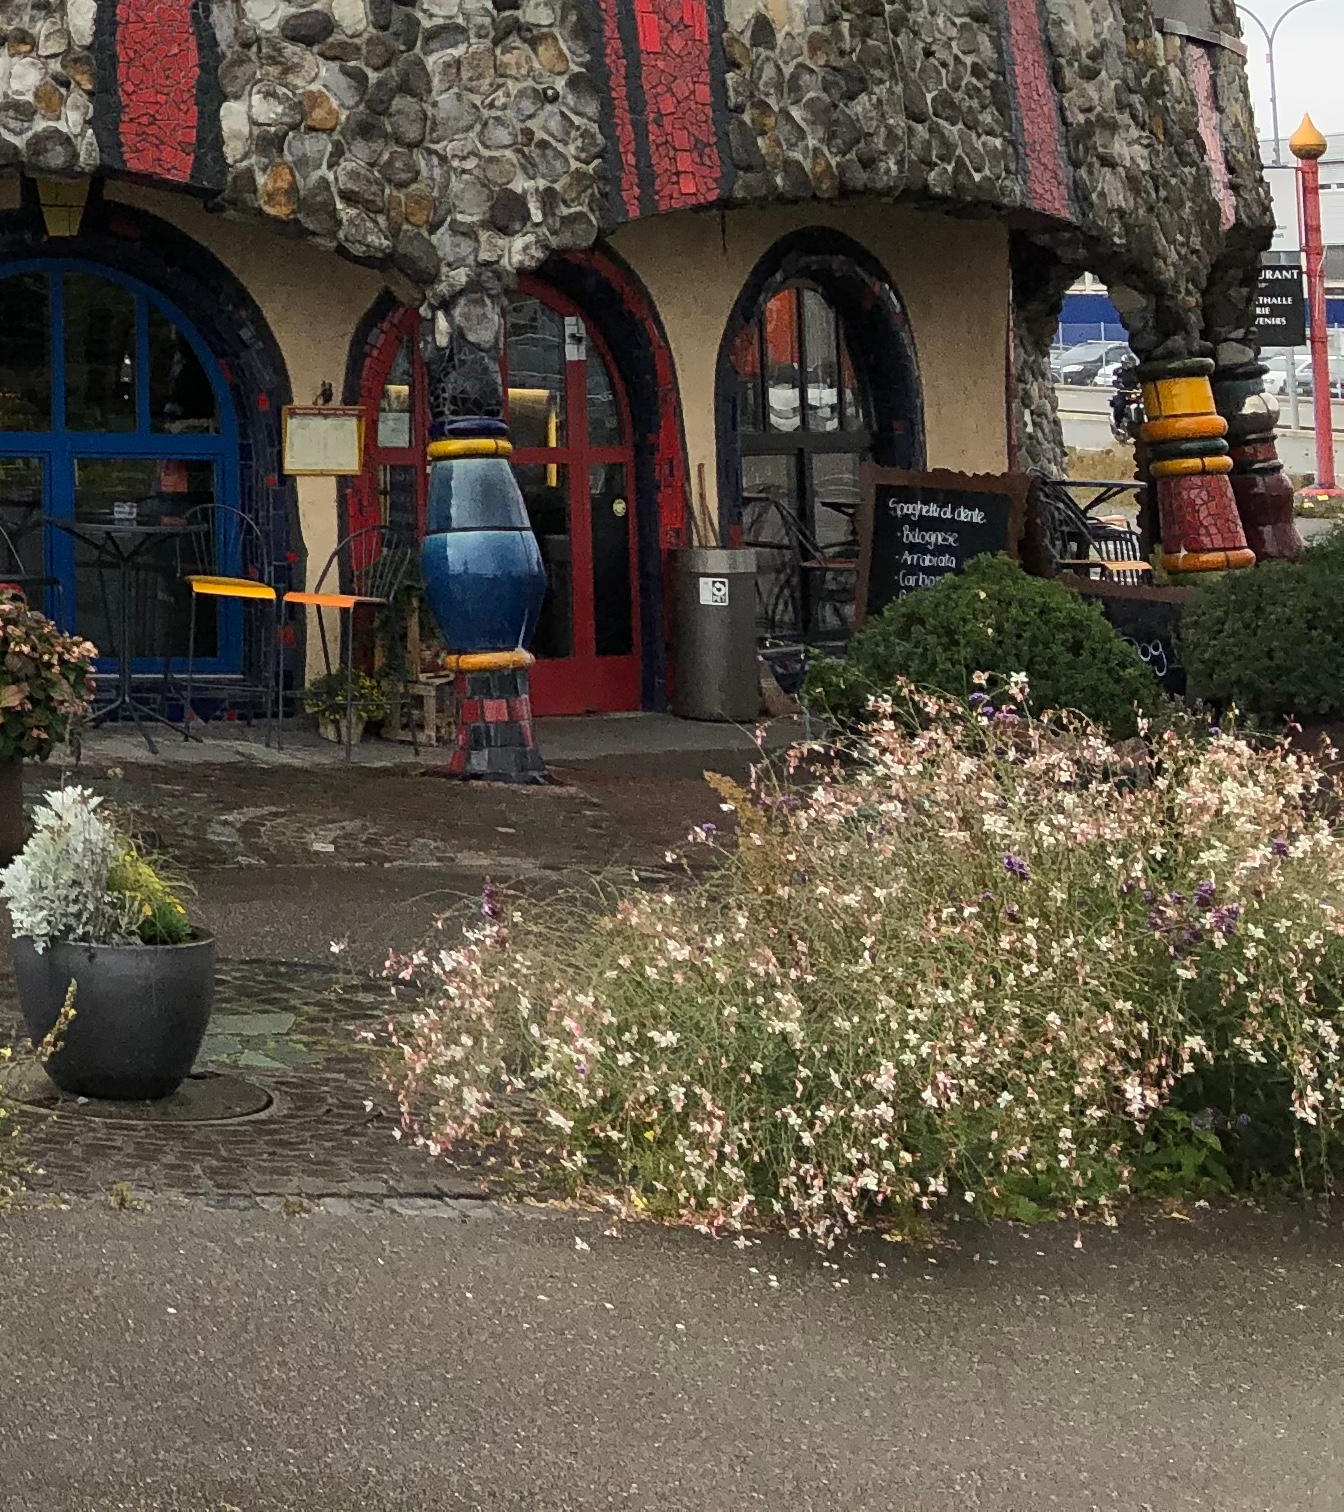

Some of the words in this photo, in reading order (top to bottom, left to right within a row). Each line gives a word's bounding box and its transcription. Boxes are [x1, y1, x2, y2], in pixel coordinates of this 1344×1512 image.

[1257, 269, 1299, 280] URANT
[1255, 296, 1293, 305] THALLE
[888, 497, 940, 521] Spaghetti
[941, 503, 954, 519] al
